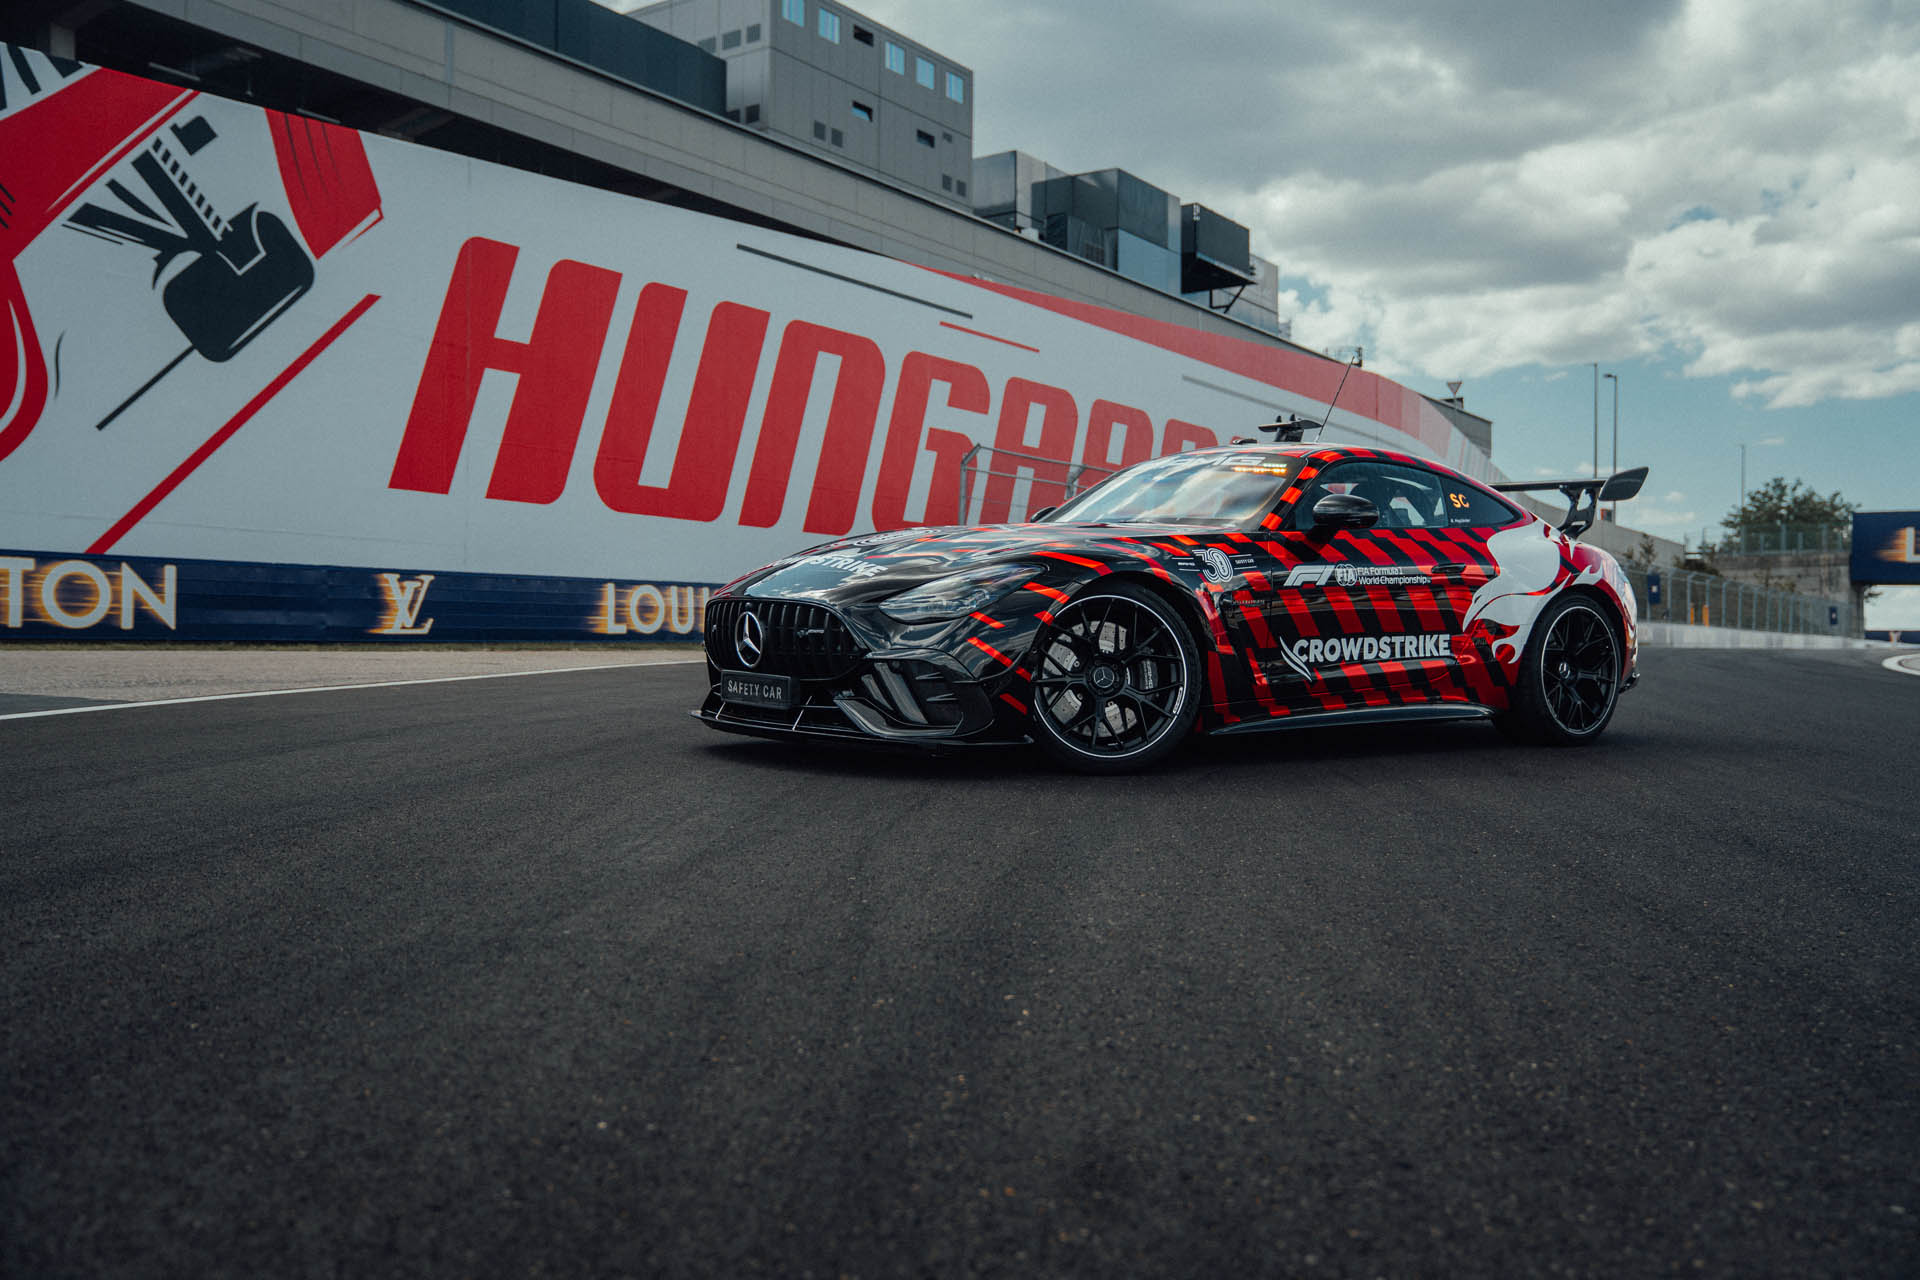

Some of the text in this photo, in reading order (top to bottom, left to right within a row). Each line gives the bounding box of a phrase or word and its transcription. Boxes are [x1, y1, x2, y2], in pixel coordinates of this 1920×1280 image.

[388, 235, 1240, 536] HUNGAR
[1449, 493, 1470, 508] SC
[1191, 548, 1233, 583] 30
[1283, 565, 1335, 586] F1
[1336, 568, 1356, 583] FIA
[1358, 567, 1369, 575] FIA
[1370, 567, 1398, 575] Formula
[1359, 576, 1379, 584] World
[0, 556, 177, 630] TON
[1292, 634, 1450, 662] CROWDSTRIKE
[727, 680, 782, 699] SAFETY CAR
